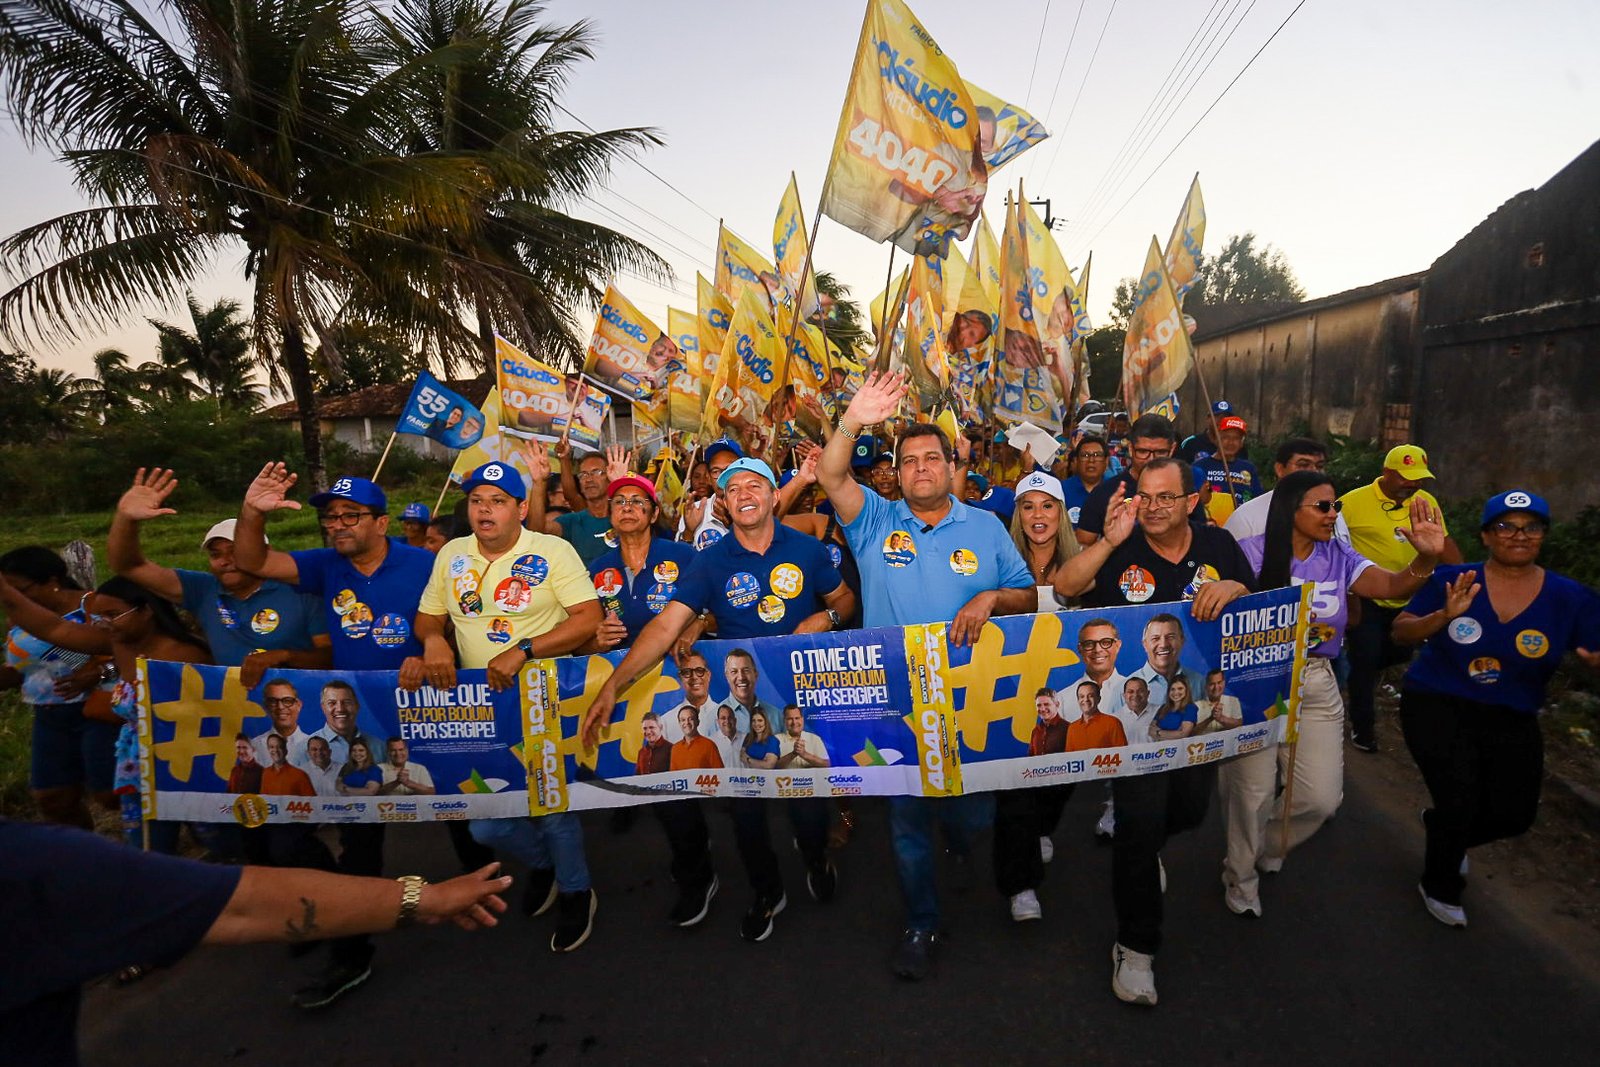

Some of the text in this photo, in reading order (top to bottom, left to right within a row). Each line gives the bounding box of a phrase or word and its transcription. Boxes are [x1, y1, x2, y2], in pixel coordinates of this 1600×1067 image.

[878, 41, 967, 129] Cláudio
[850, 117, 952, 192] 4040
[600, 303, 648, 344] Cláudio
[502, 359, 559, 385] Cláudio
[417, 386, 450, 413] 55
[486, 468, 500, 477] 55
[334, 479, 352, 491] 55
[1509, 495, 1527, 505] 55
[776, 567, 799, 582] 40
[773, 578, 797, 592] 40
[1129, 583, 1148, 593] 444
[732, 593, 759, 607] 55555
[1221, 602, 1301, 637] O TIME QU
[1456, 623, 1475, 637] 55
[1221, 627, 1297, 653] FAZ POR BOQU
[1521, 634, 1543, 646] 55
[790, 650, 804, 673] O
[804, 647, 847, 672] TIME
[847, 645, 884, 671] QUE
[1221, 641, 1296, 671] E POR SERGIP
[793, 669, 887, 689] FAZ POR BOQUIM
[395, 684, 493, 708] O TIME QUE
[795, 685, 888, 708] E POR SERGIPE!
[399, 707, 494, 722] FAZ POR BOQUIM
[401, 721, 496, 739] E POR SERGIPE!
[1238, 728, 1268, 740] Cláudio
[921, 709, 945, 791] 4040
[1164, 747, 1177, 755] 55
[1066, 760, 1085, 773] 131
[1092, 753, 1122, 767] 444
[672, 779, 688, 792] 131
[695, 775, 720, 787] 444
[828, 775, 863, 784] Cláudio
[778, 788, 814, 796] 55555
[286, 800, 313, 814] 444
[432, 800, 468, 809] Cláudio
